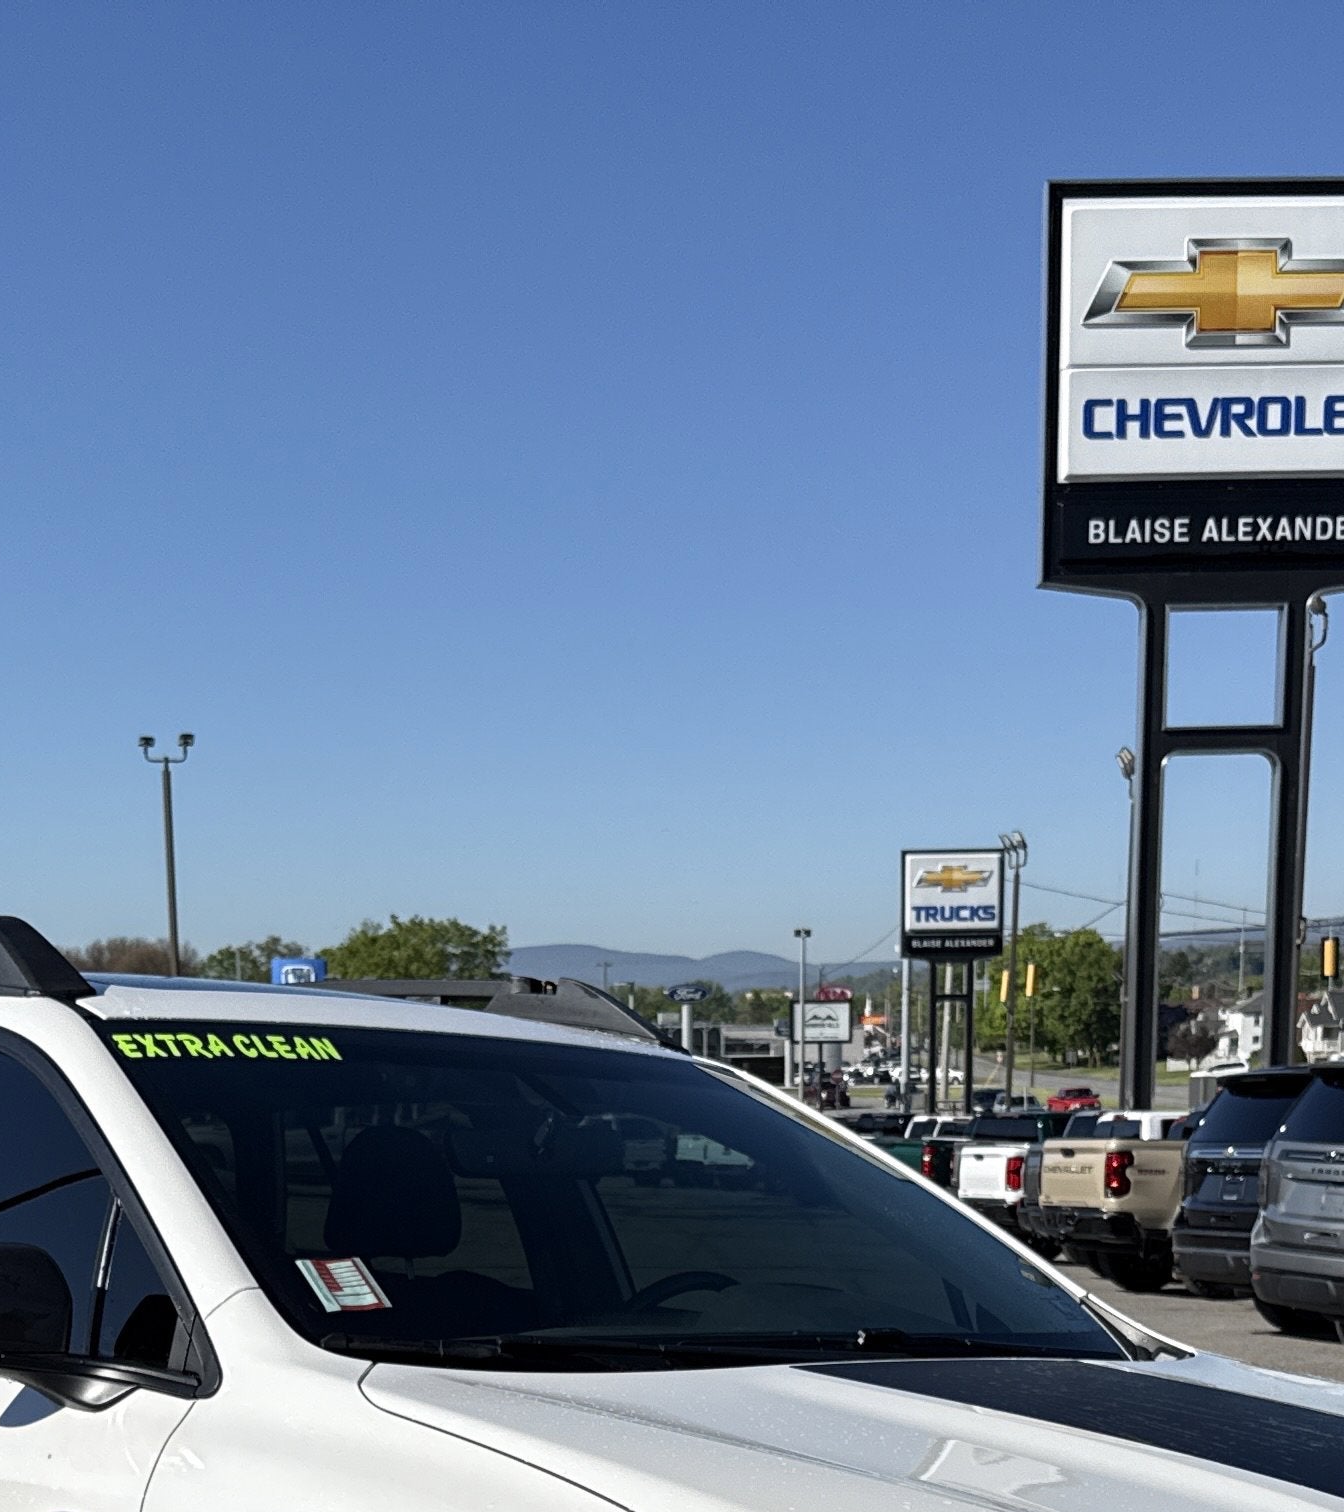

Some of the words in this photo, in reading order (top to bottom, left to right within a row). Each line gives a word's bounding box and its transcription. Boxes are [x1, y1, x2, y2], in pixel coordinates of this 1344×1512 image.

[1088, 517, 1190, 544] BLAISE
[911, 905, 996, 922] TRUCKS
[911, 939, 942, 949] BLAISE
[944, 938, 995, 948] ALEXANDER
[112, 1033, 235, 1058] EXTRA
[232, 1034, 343, 1061] CLEAN
